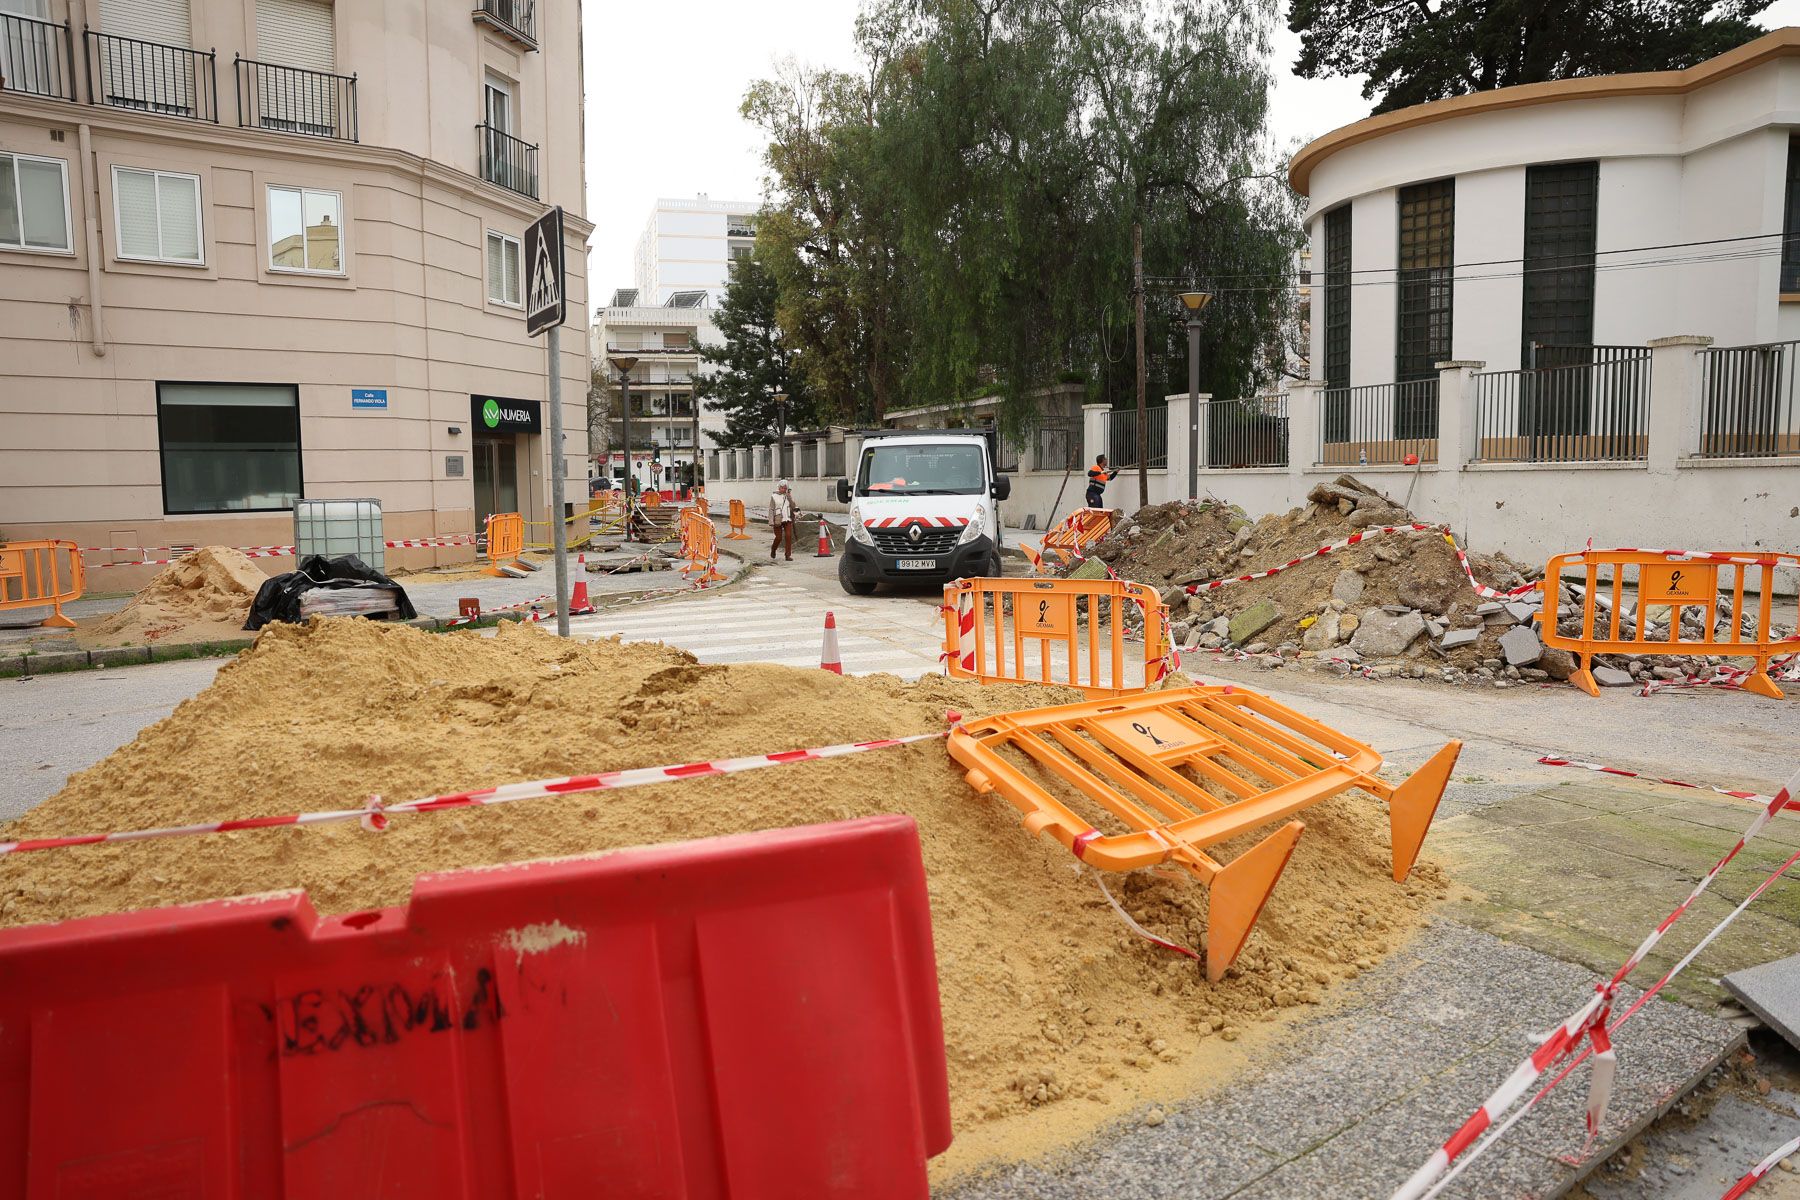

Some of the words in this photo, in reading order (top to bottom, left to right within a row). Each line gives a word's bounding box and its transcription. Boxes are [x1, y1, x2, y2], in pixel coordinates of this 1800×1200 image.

[499, 408, 532, 422] NUMERIA
[901, 560, 919, 568] 9912
[921, 560, 935, 568] MVX
